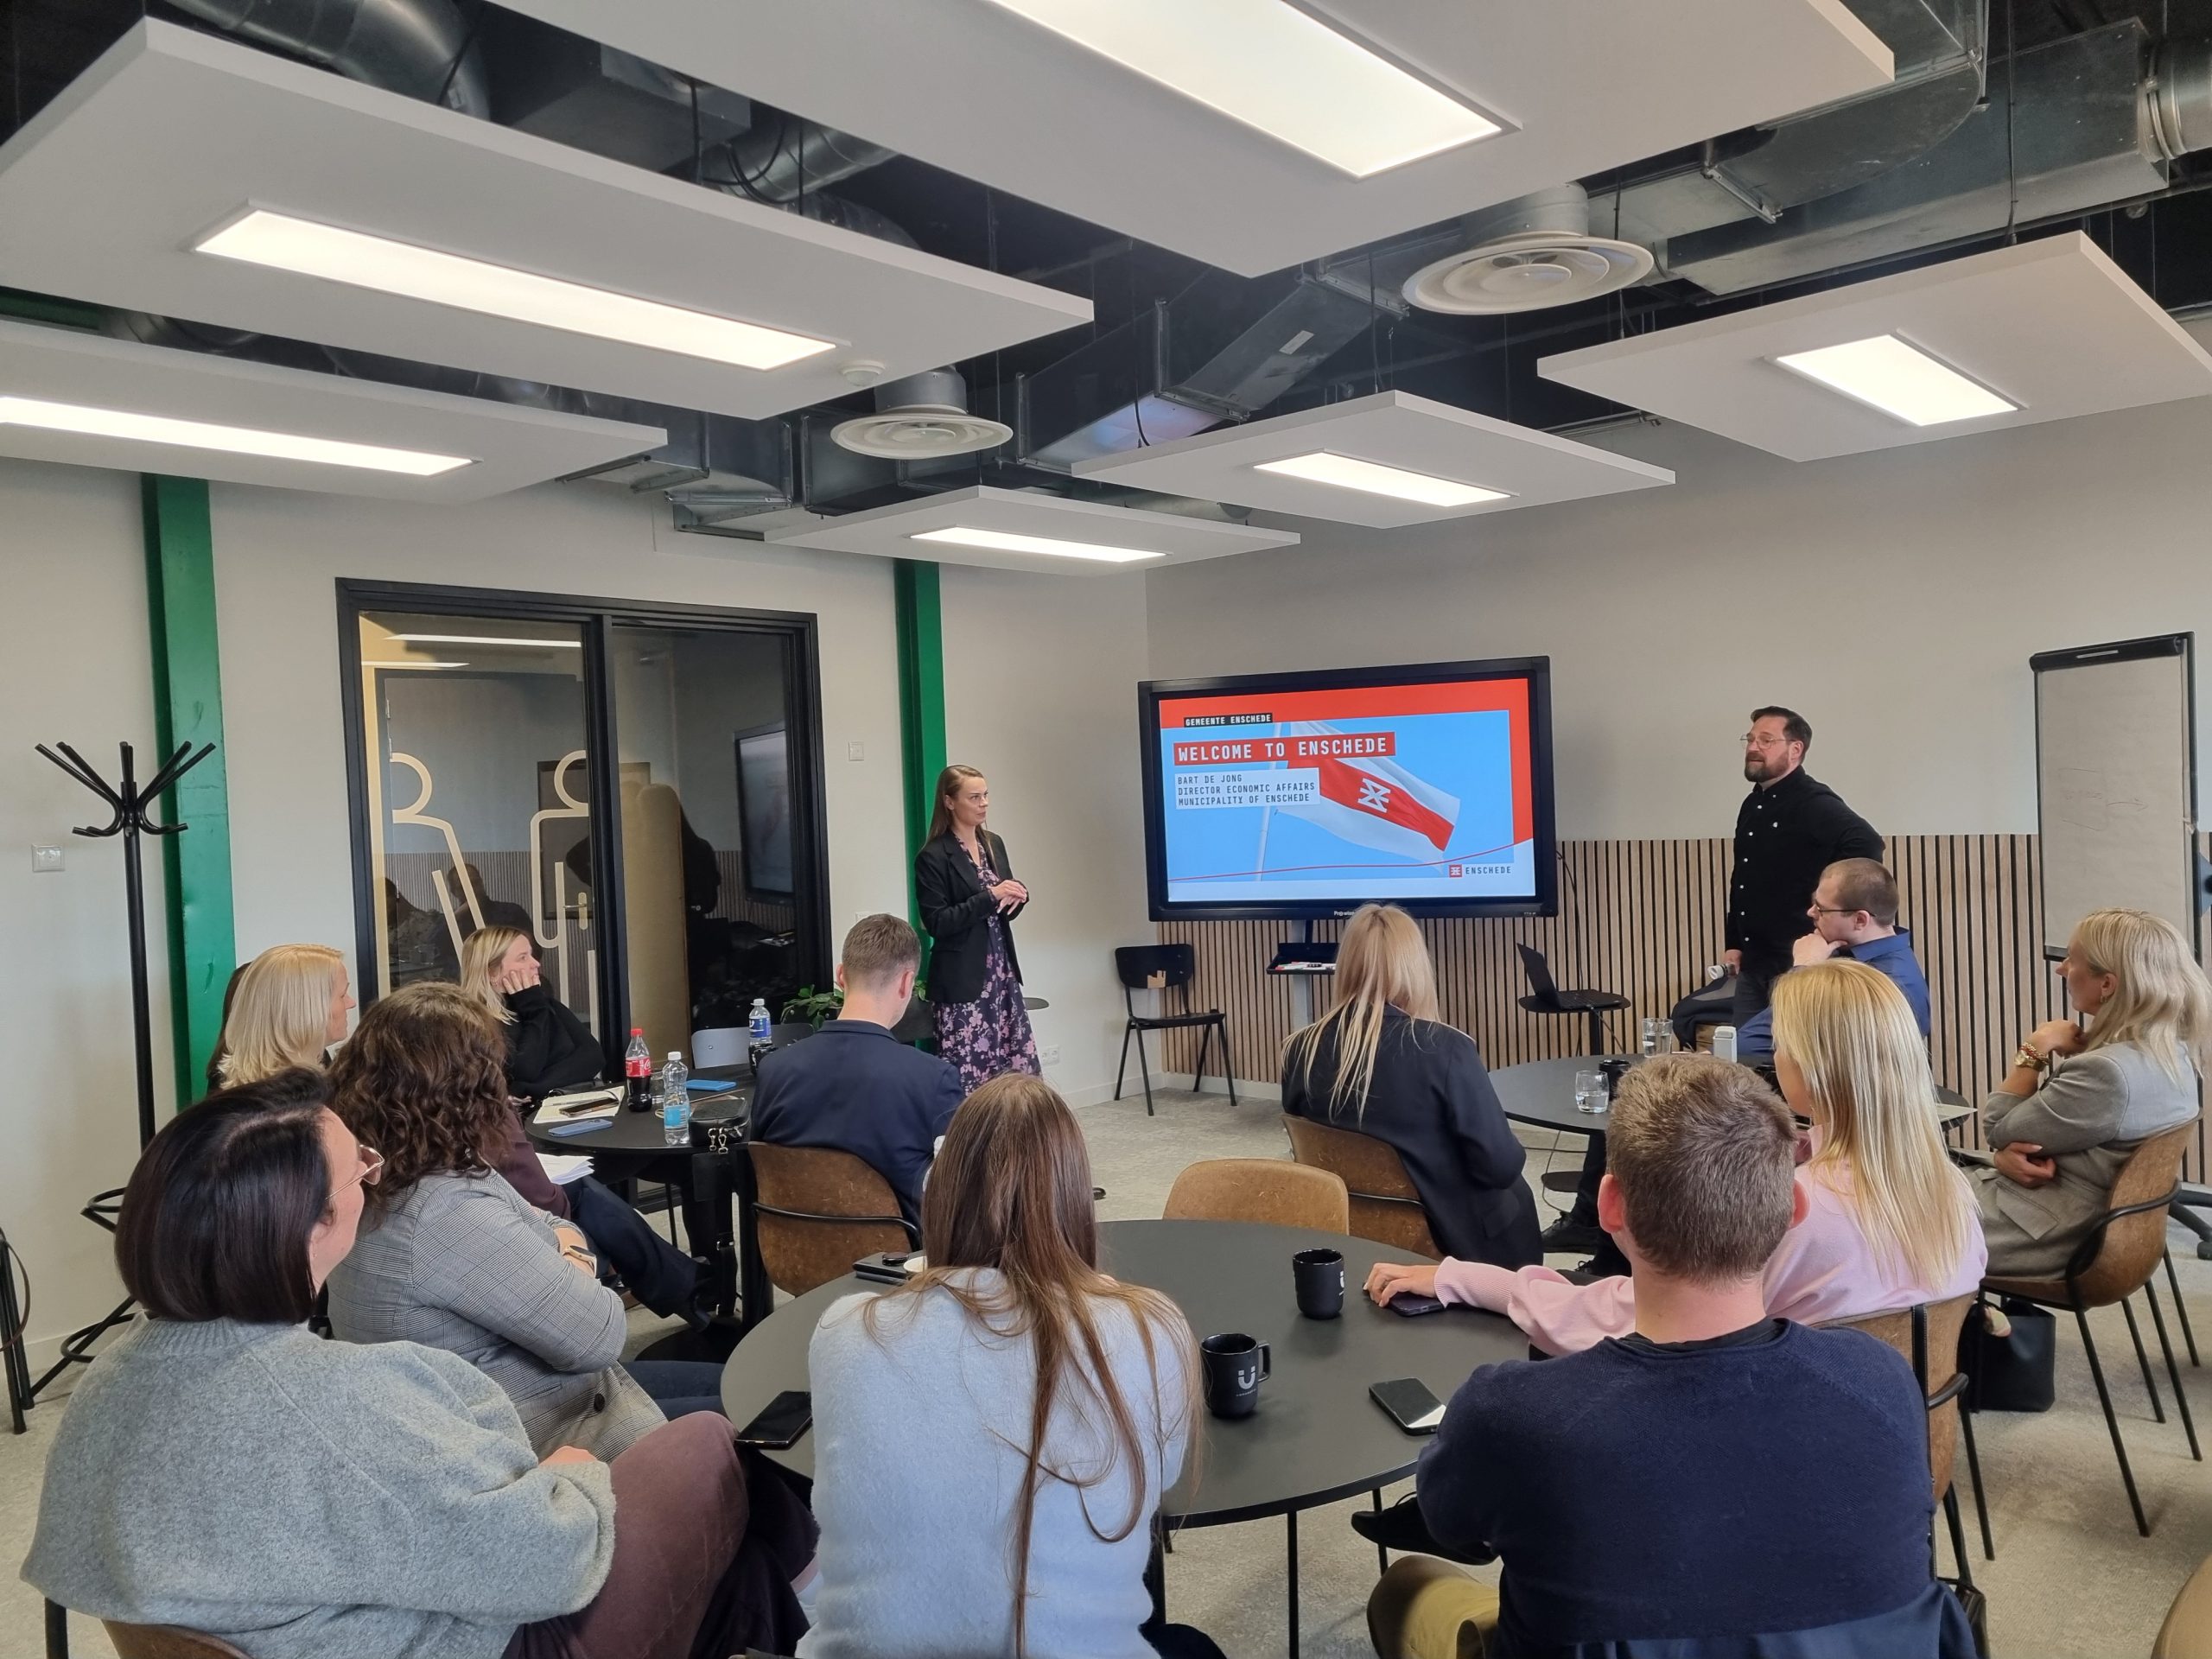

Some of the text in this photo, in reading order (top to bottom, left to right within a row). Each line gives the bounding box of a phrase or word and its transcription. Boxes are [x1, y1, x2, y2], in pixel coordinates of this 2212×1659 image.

[1185, 714, 1271, 726] GEMEENTE ENSCHEDE
[1178, 737, 1387, 761] WELCOME TO ENSCHEDE
[1178, 774, 1243, 785] BART DE JONG
[1178, 782, 1315, 795] DIRECTOR ECONOMIC AFFAIRS
[1179, 793, 1310, 805] MUNICIPALITY OF ENSCHEDE
[1465, 866, 1511, 874] ENSCHEDE
